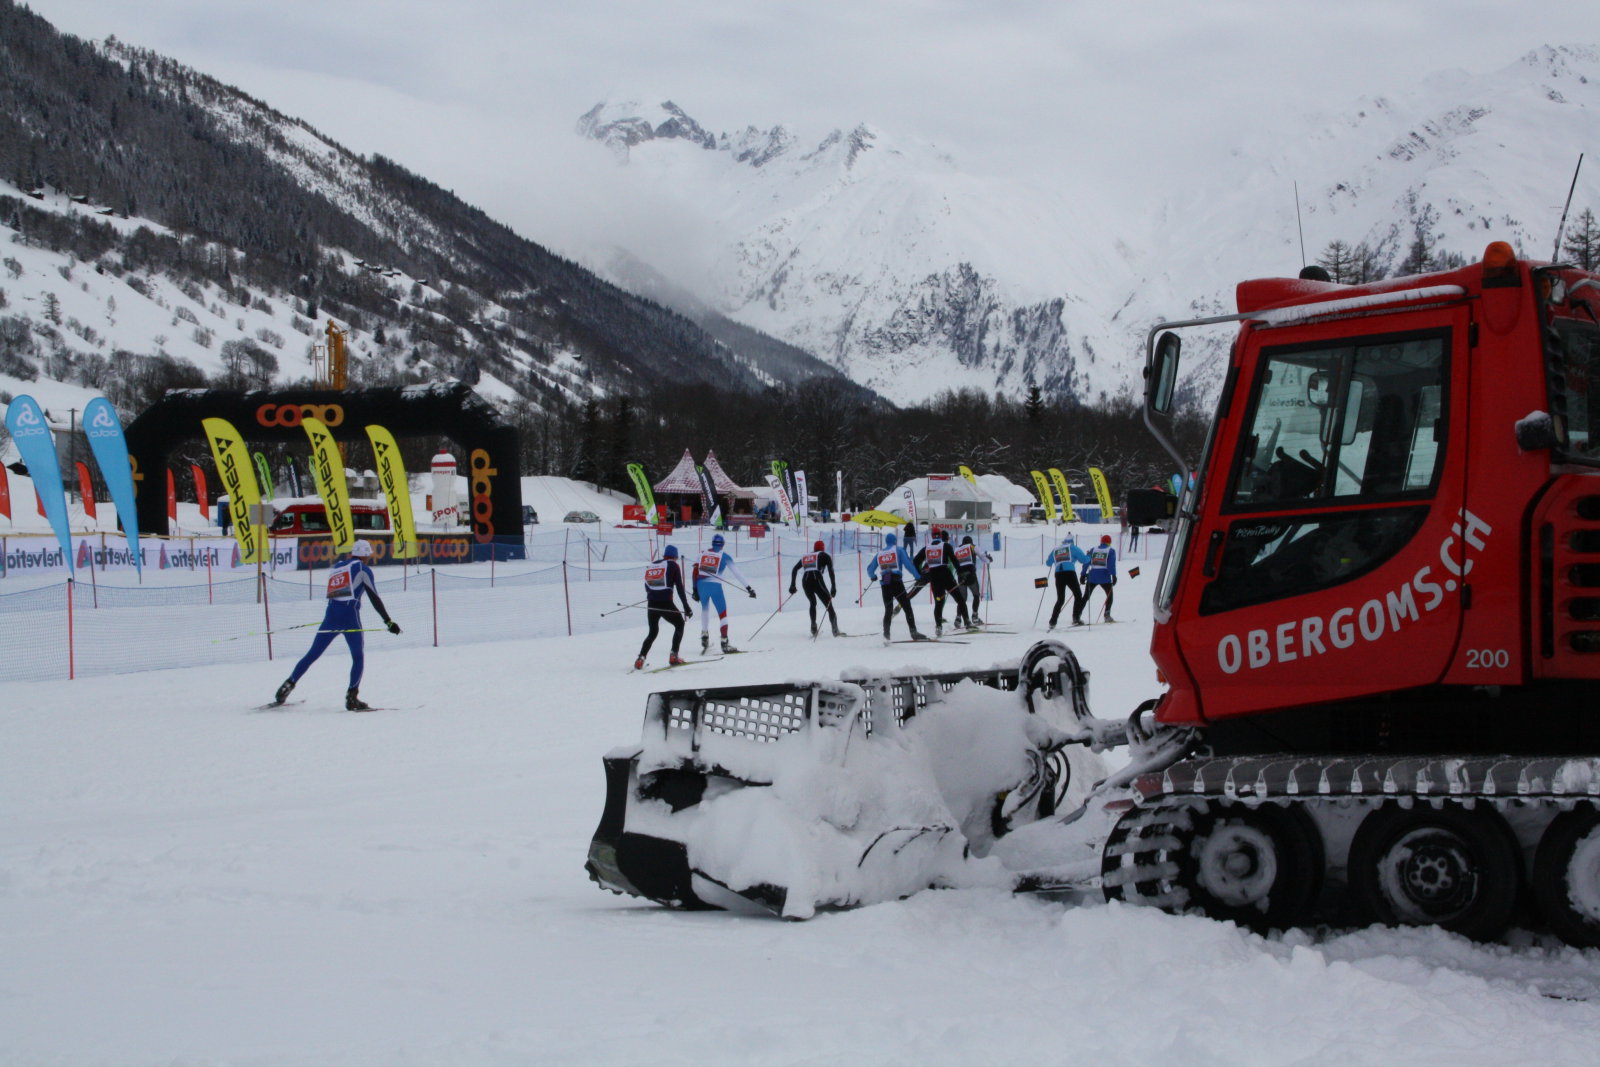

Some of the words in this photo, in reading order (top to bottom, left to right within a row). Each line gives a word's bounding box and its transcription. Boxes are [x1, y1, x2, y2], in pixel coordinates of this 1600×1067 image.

[256, 403, 344, 427] coop
[471, 448, 498, 544] coop
[433, 538, 469, 563] coop
[330, 576, 345, 586] 437
[648, 568, 663, 576] 597
[1217, 507, 1492, 674] OBERGOMS.CH
[1465, 648, 1509, 669] 200
